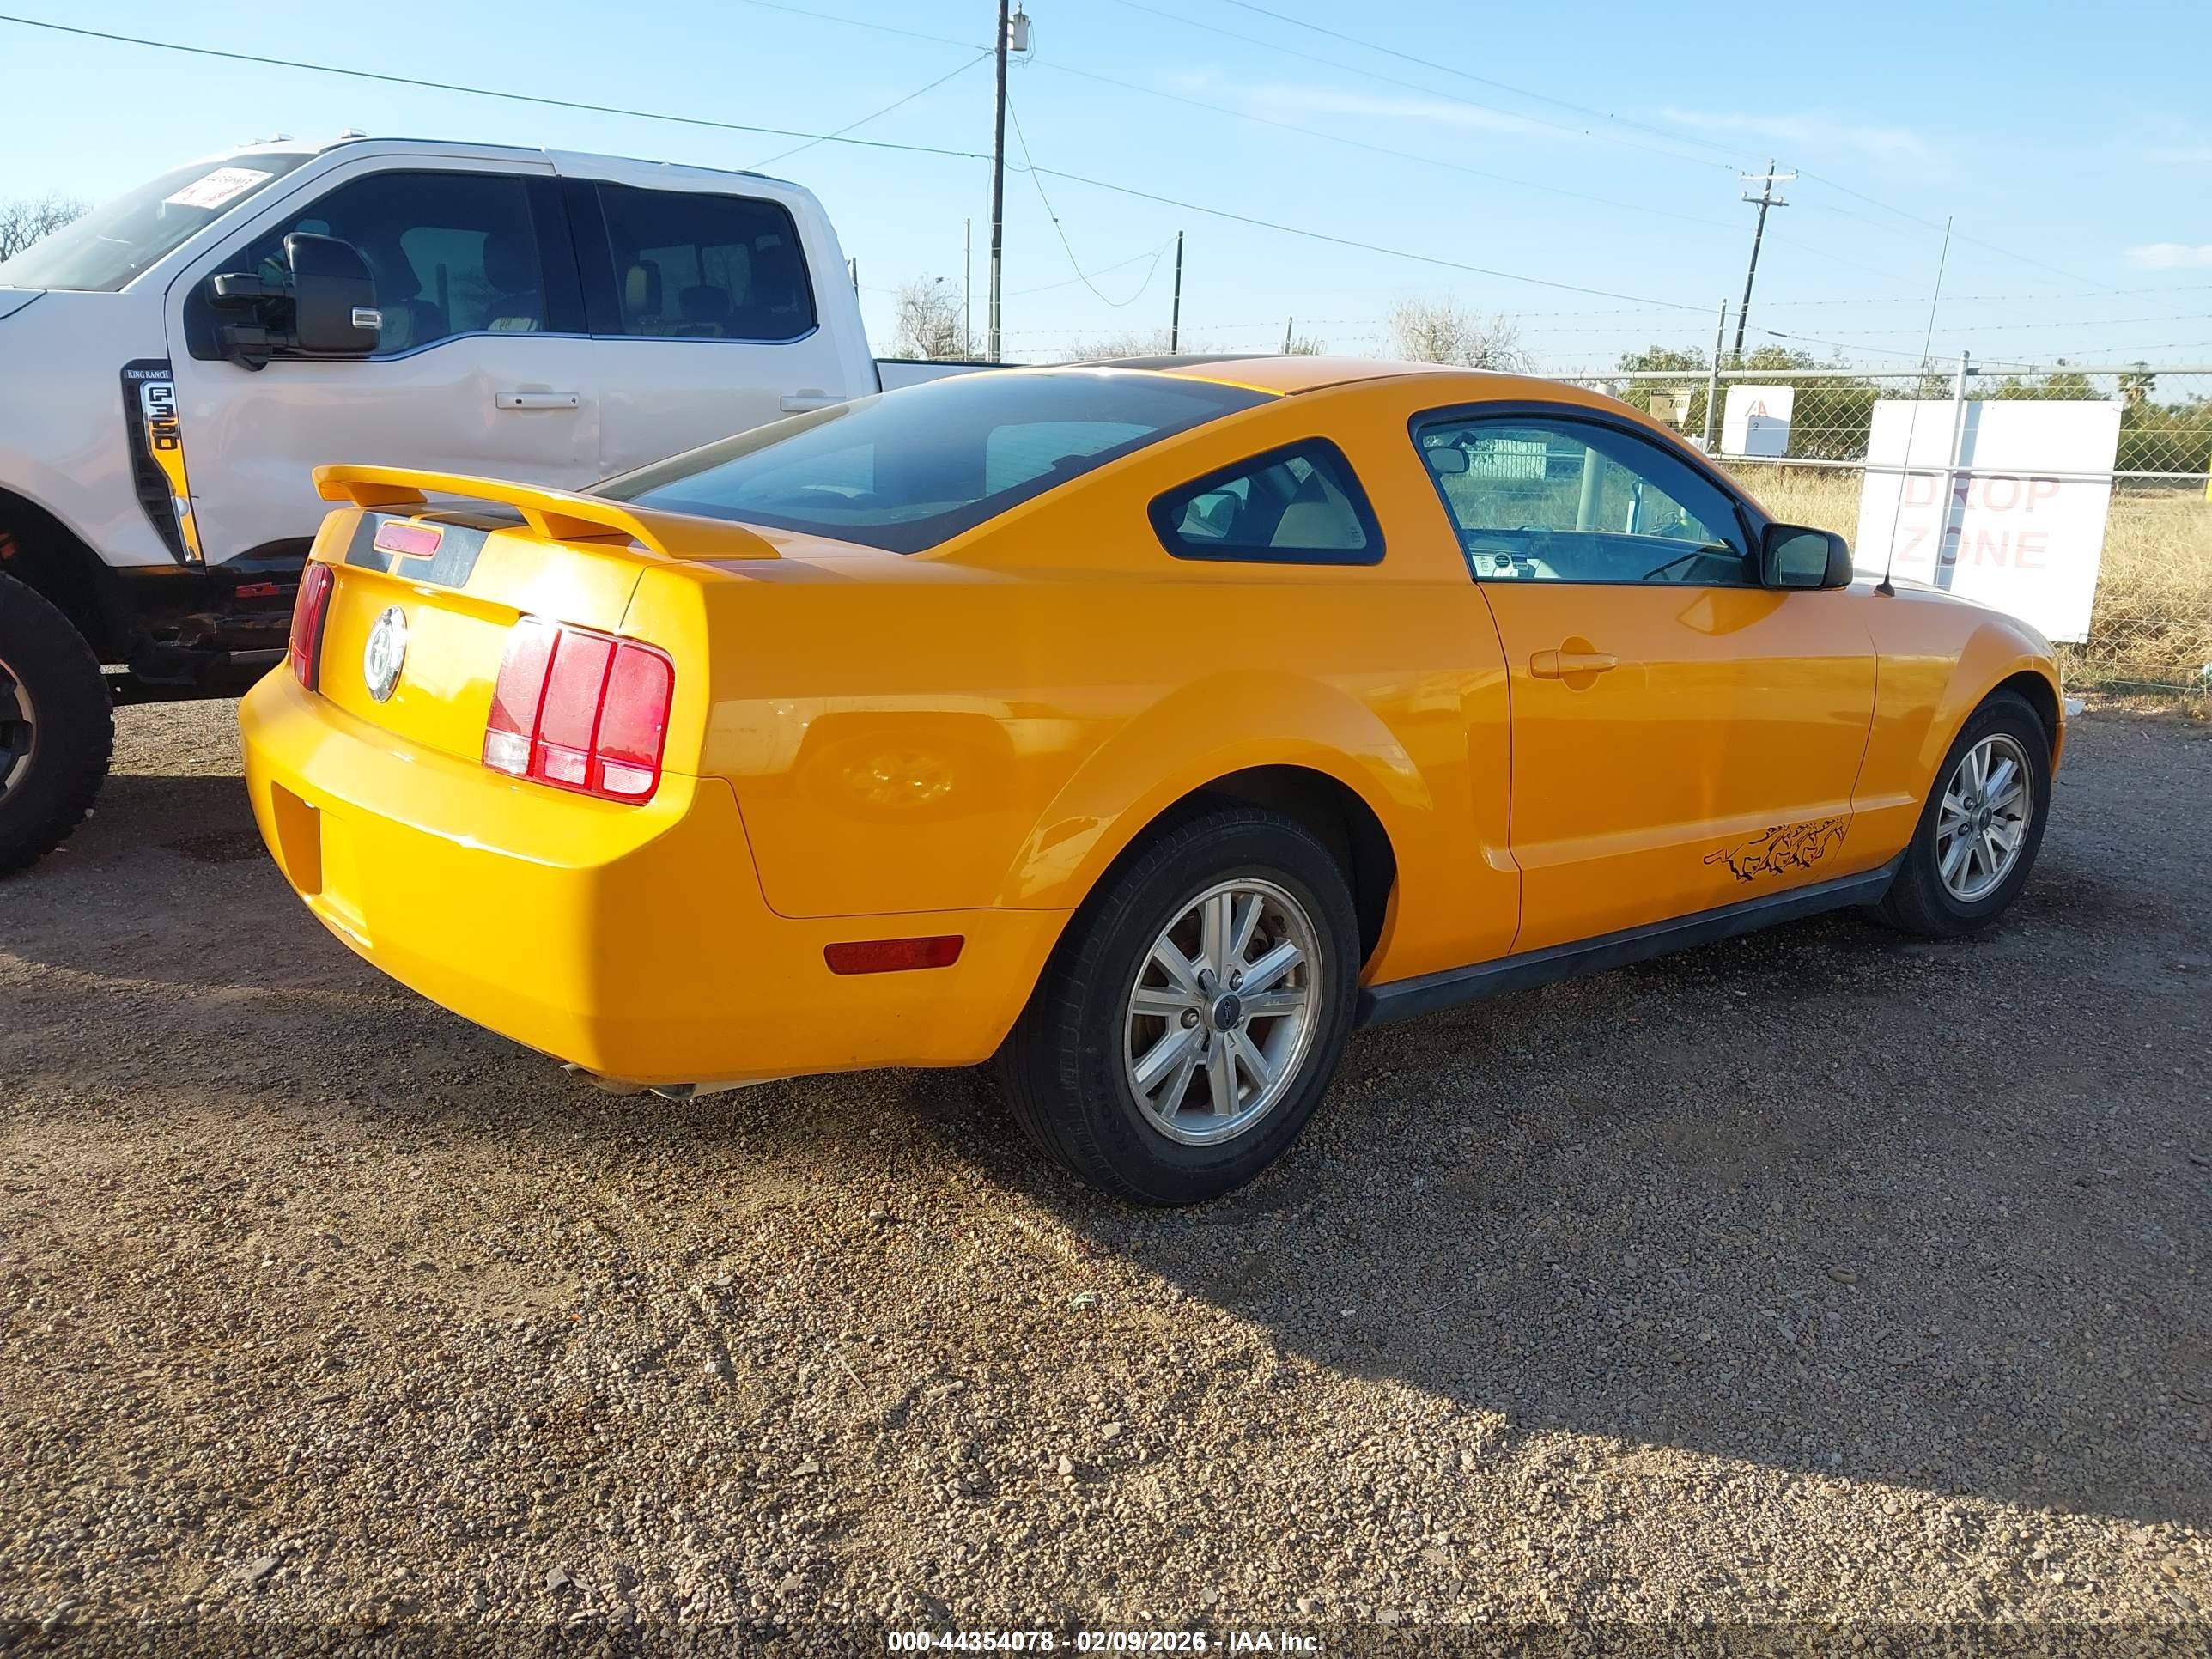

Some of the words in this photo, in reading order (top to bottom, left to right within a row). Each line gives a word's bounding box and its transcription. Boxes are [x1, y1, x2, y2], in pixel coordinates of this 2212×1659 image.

[127, 369, 144, 379] KING
[145, 370, 169, 379] RANCH
[1904, 471, 2060, 513] DROP
[1896, 526, 2049, 570] ZONE
